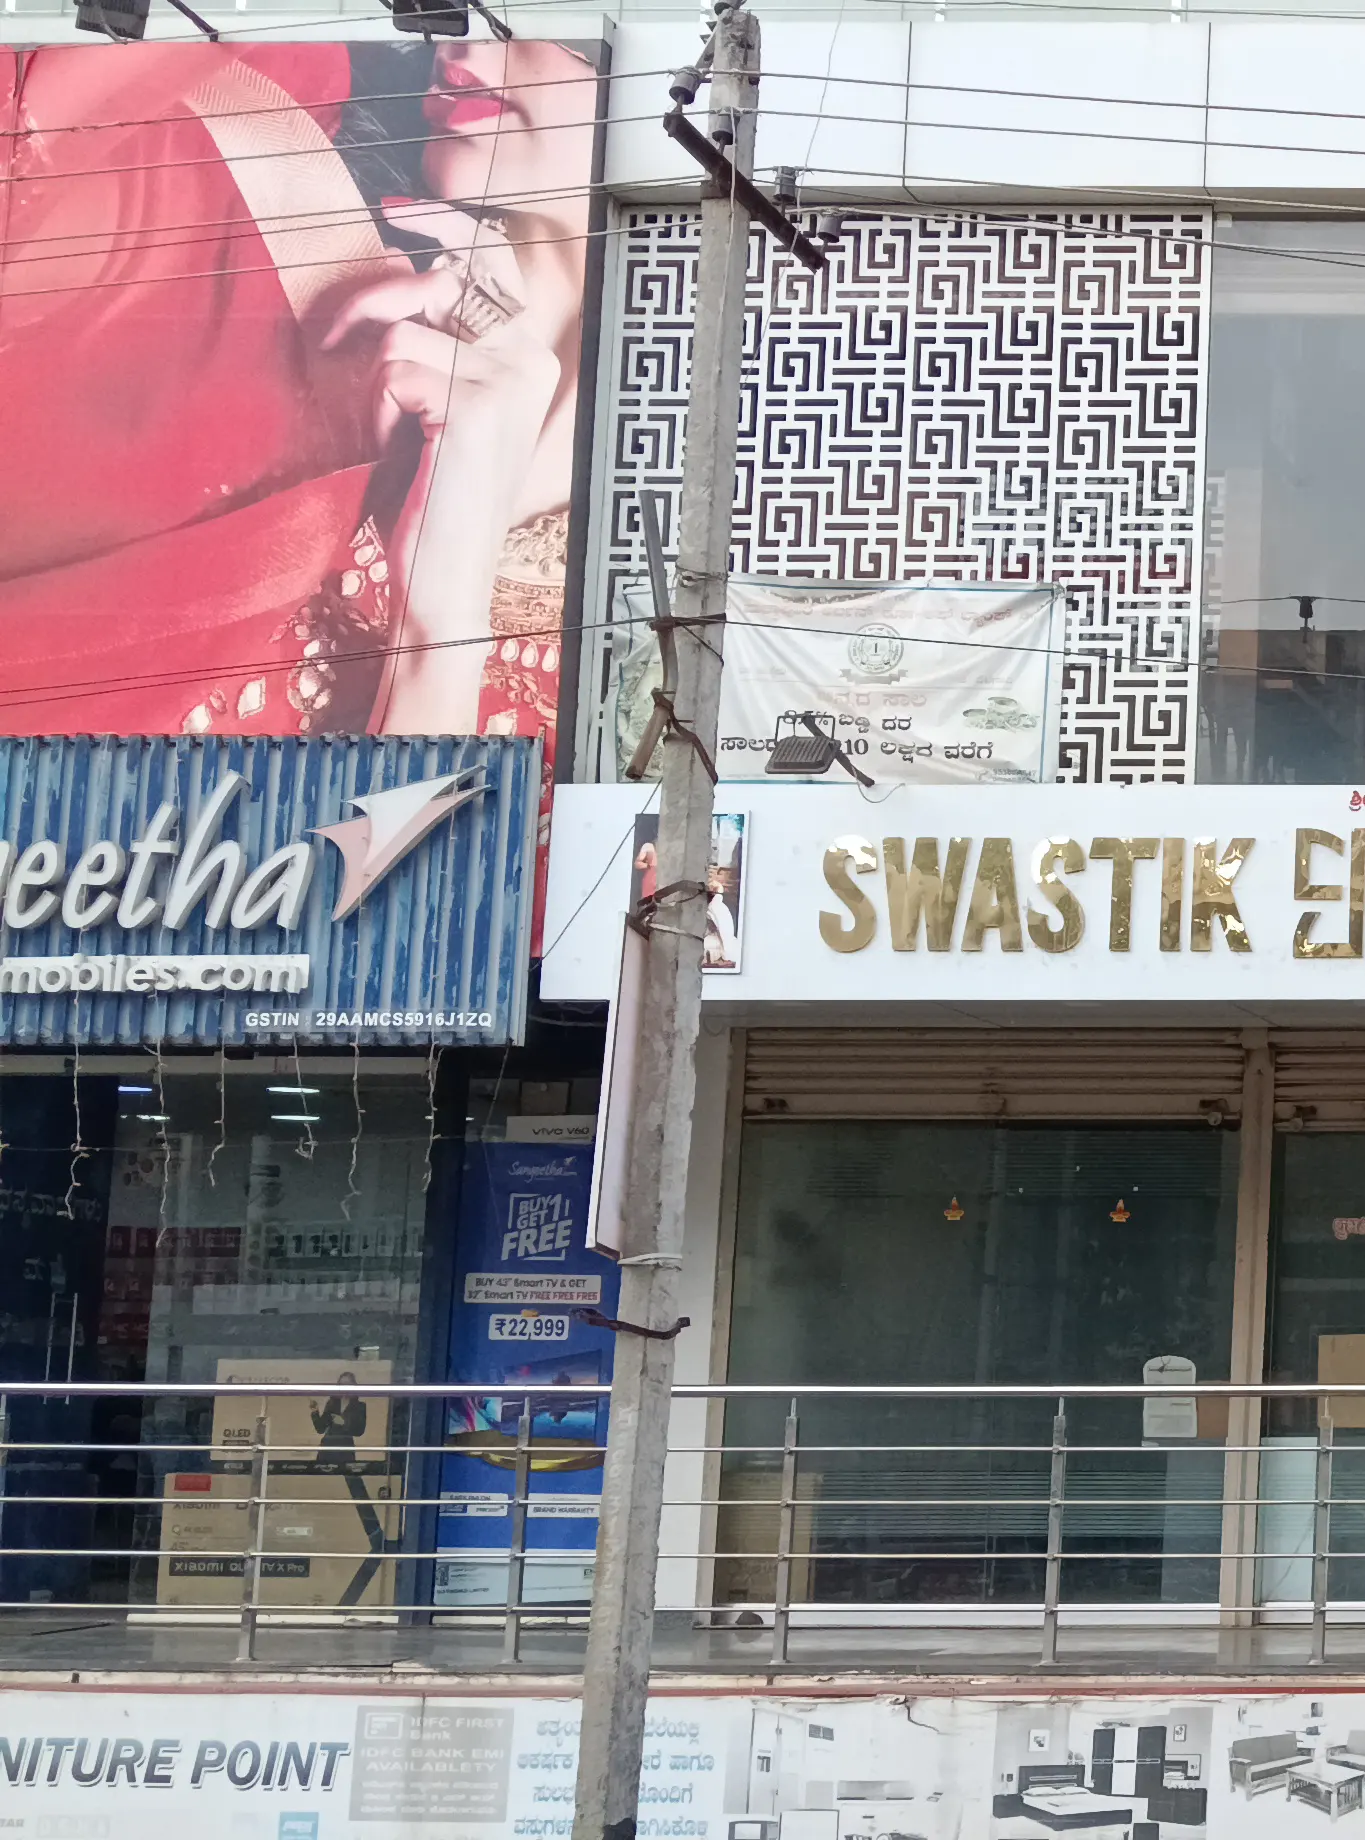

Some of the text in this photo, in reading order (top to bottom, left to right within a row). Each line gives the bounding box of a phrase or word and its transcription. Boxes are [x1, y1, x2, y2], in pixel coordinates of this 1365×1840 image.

[880, 714, 913, 732] ದರ
[943, 740, 994, 760] ವರೆಗೆ
[0, 770, 316, 932] eetha
[818, 833, 1257, 953] SWASTIK
[1, 954, 310, 995] mobiles.com
[245, 1012, 300, 1028] GSTIN
[315, 1011, 493, 1028] 29AAMCS5916J1ZQ
[518, 1193, 563, 1223] BUY 1
[516, 1209, 549, 1230] GET
[500, 1218, 574, 1262] FREE
[475, 1277, 494, 1288] BUY
[545, 1278, 558, 1288] TV
[568, 1278, 588, 1288] GET
[529, 1291, 550, 1300] FREE
[552, 1291, 574, 1300] FREE
[576, 1291, 598, 1301] FREE
[493, 1316, 566, 1341] ₹22,999
[455, 1717, 506, 1729] FIRST
[410, 1729, 452, 1742] Bank
[411, 1748, 465, 1759] BANK
[472, 1748, 505, 1760] EMI
[190, 1739, 351, 1791] POINT
